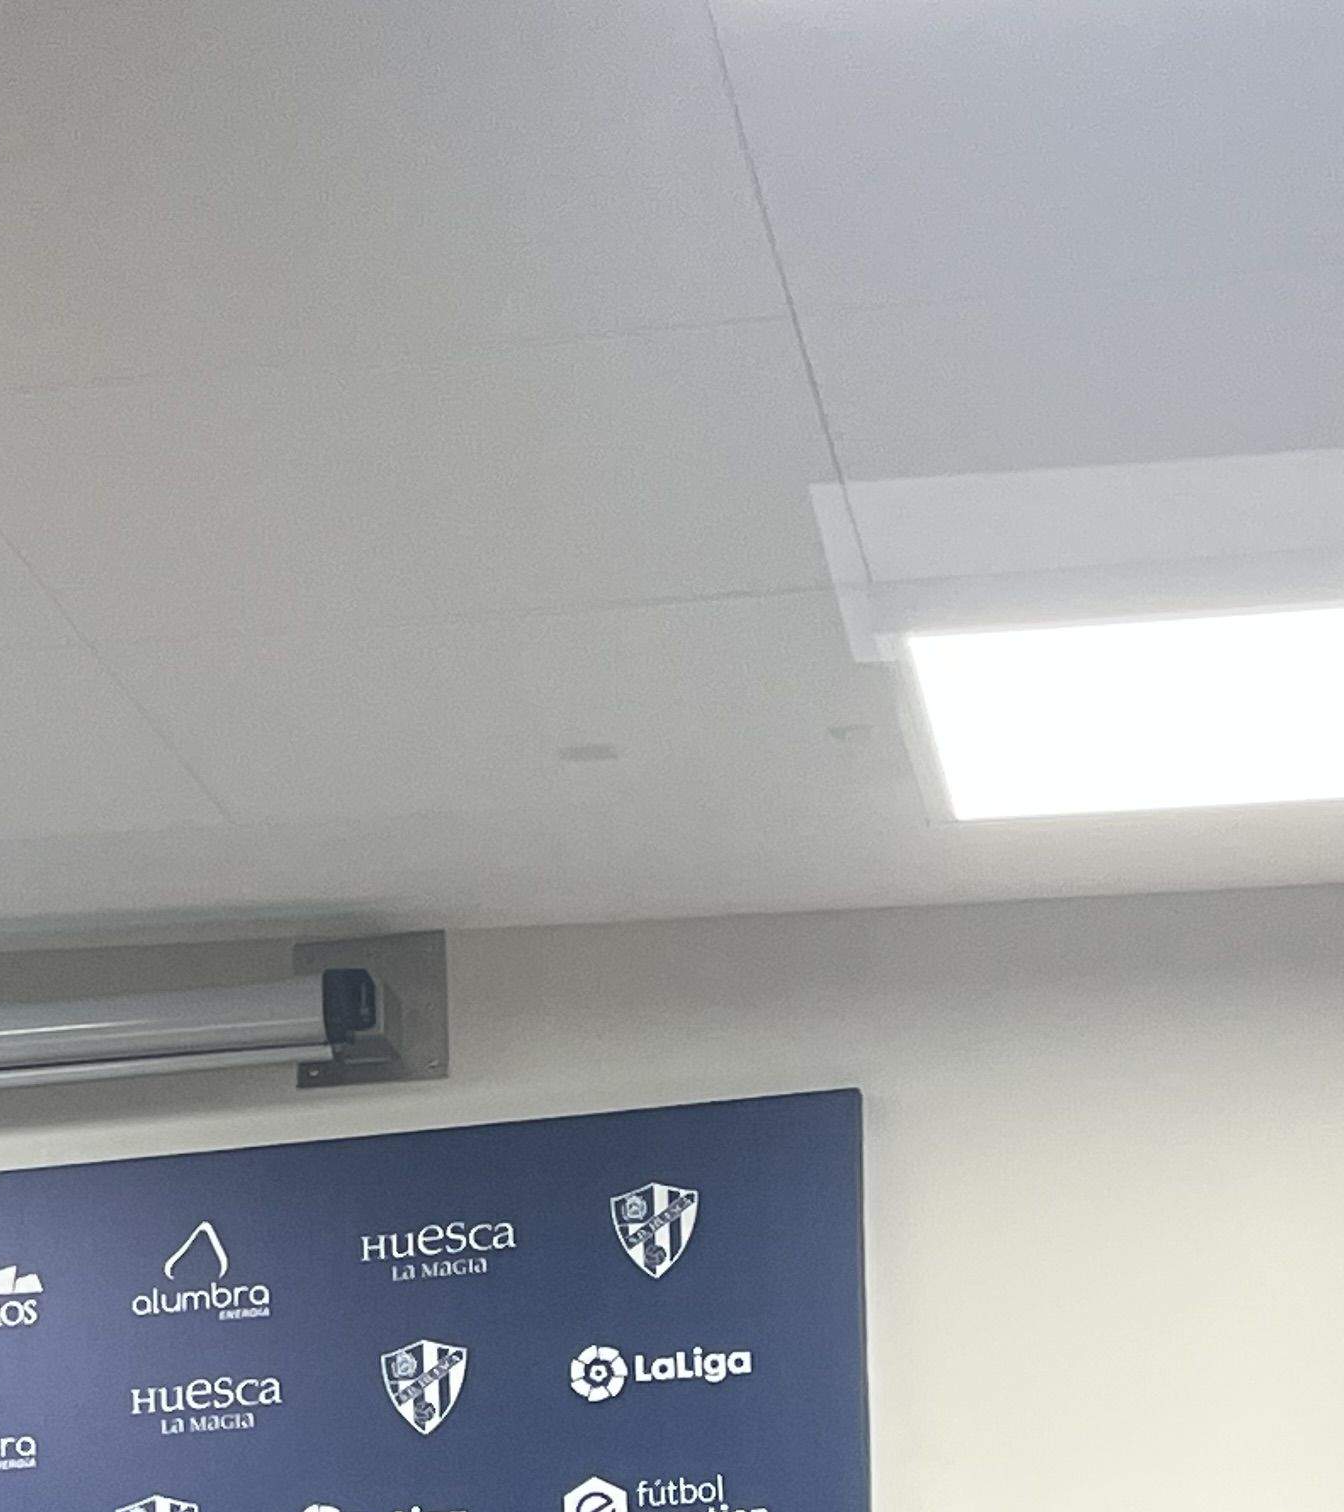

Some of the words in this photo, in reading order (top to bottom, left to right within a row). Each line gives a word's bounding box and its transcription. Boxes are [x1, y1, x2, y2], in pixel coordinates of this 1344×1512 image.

[132, 1282, 269, 1315] alumbra
[635, 1347, 751, 1382] LaLiga
[636, 1474, 723, 1507] fútbol
